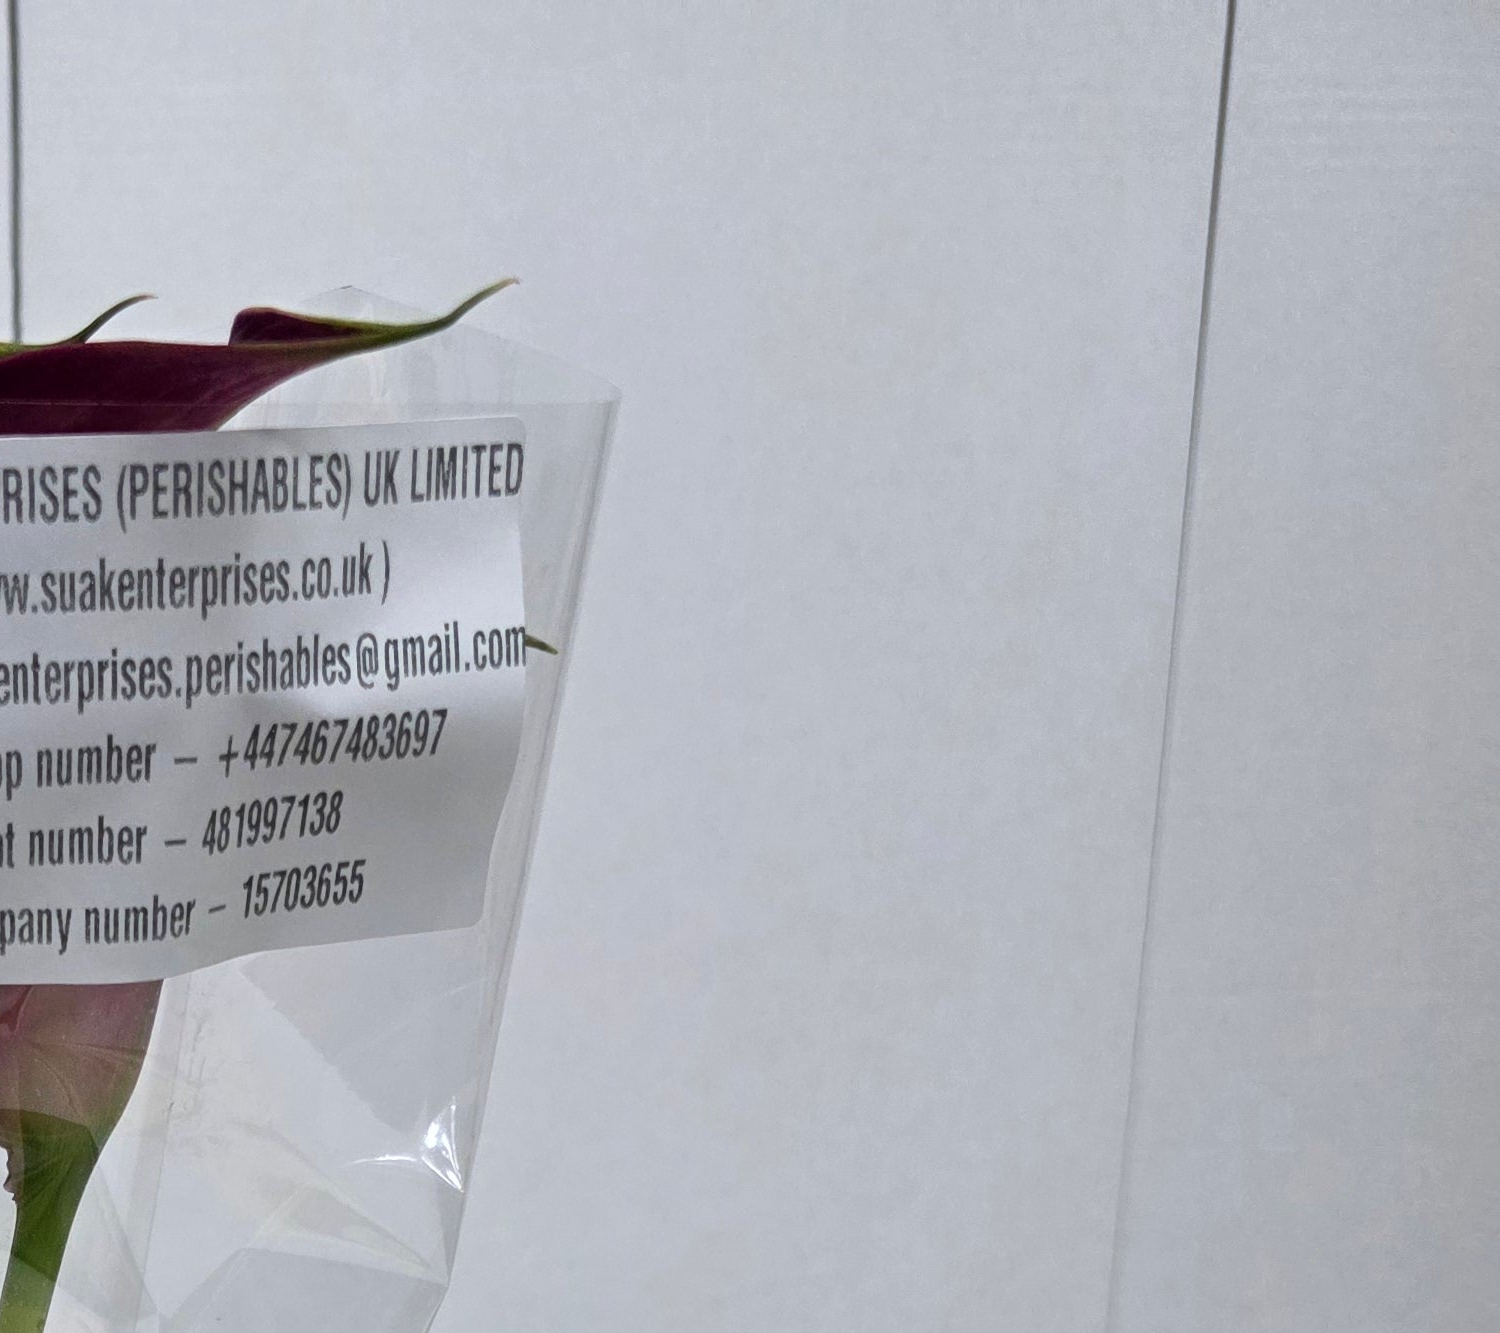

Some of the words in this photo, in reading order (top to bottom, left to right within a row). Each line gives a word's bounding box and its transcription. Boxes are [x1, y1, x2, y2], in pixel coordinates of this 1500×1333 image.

[117, 453, 351, 533] (PERISHABLES)
[364, 450, 400, 507] UK
[411, 443, 524, 502] LIMITED
[37, 734, 156, 787] number
[219, 709, 447, 777] +447467483697
[29, 816, 147, 865] number
[203, 790, 343, 854] 481997138
[85, 895, 196, 944] number
[243, 859, 366, 918] 15703655
